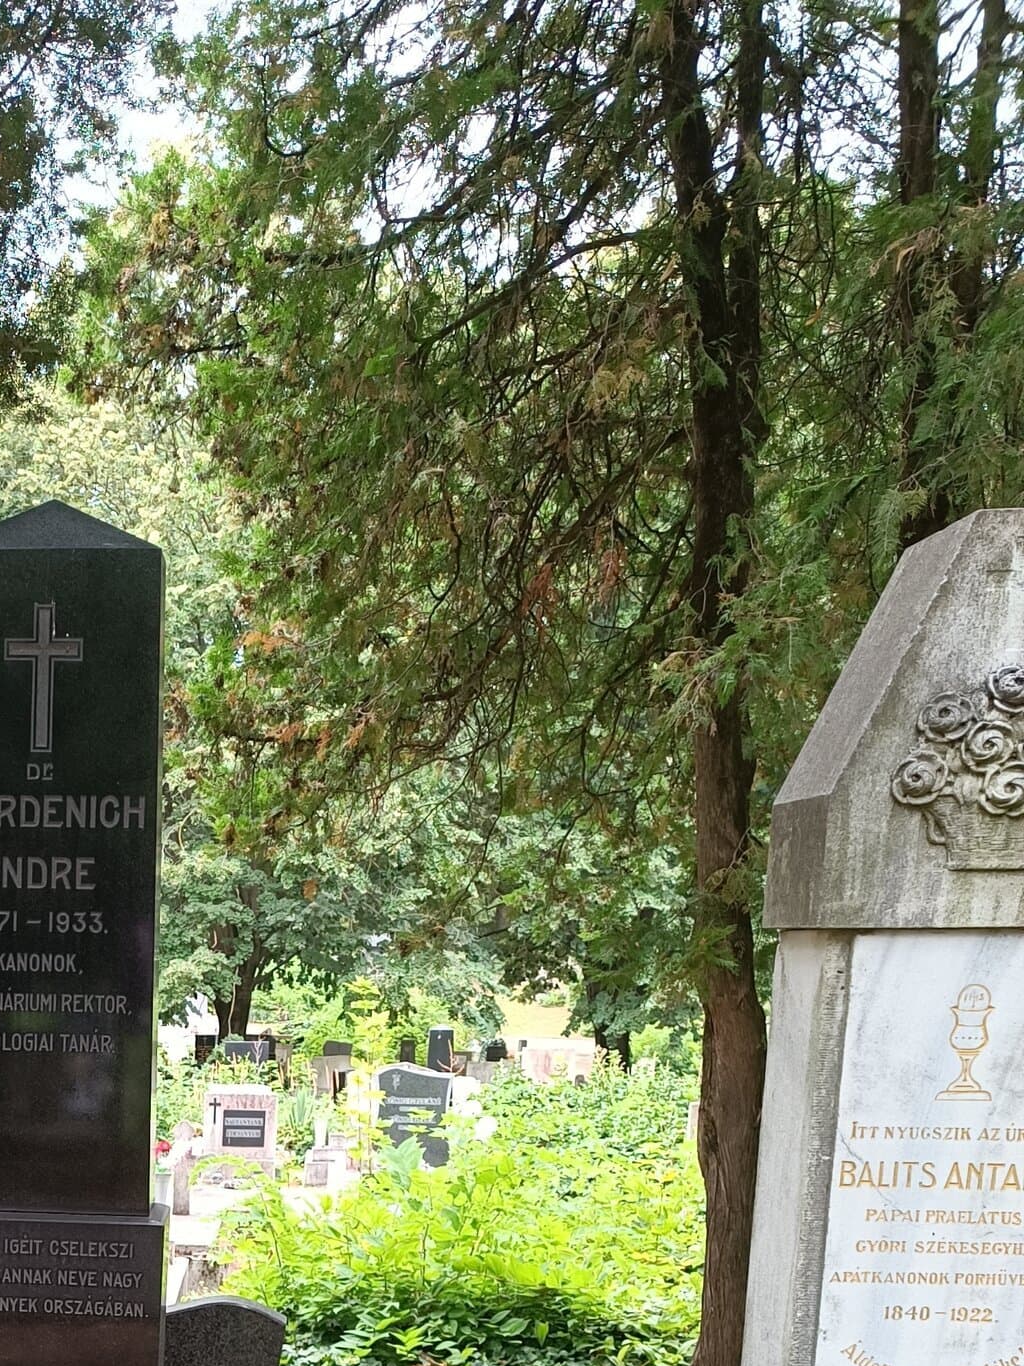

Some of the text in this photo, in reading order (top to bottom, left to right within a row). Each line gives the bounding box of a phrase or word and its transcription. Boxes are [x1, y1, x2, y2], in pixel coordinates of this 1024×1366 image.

[48, 911, 109, 934] 1933.
[61, 995, 132, 1016] REKTOR,
[850, 1121, 879, 1139] ITT
[884, 1126, 971, 1140] NYUGSZIK
[977, 1127, 1001, 1141] AZ
[839, 1160, 1024, 1190] BALITS ANTA
[925, 1210, 1022, 1226] PRAELATUS
[4, 1234, 43, 1255] IGÉIT
[49, 1240, 134, 1259] CSELEKSZI
[914, 1236, 1024, 1256] SZÉKESEGYH
[2, 1267, 52, 1284] ANNAK
[57, 1269, 97, 1287] NEVE
[103, 1271, 143, 1288] NAGY
[829, 1266, 950, 1284] APÁTKANONOK
[44, 1295, 149, 1318] ORSZÁGÁBAN.
[884, 1305, 930, 1321] 1840
